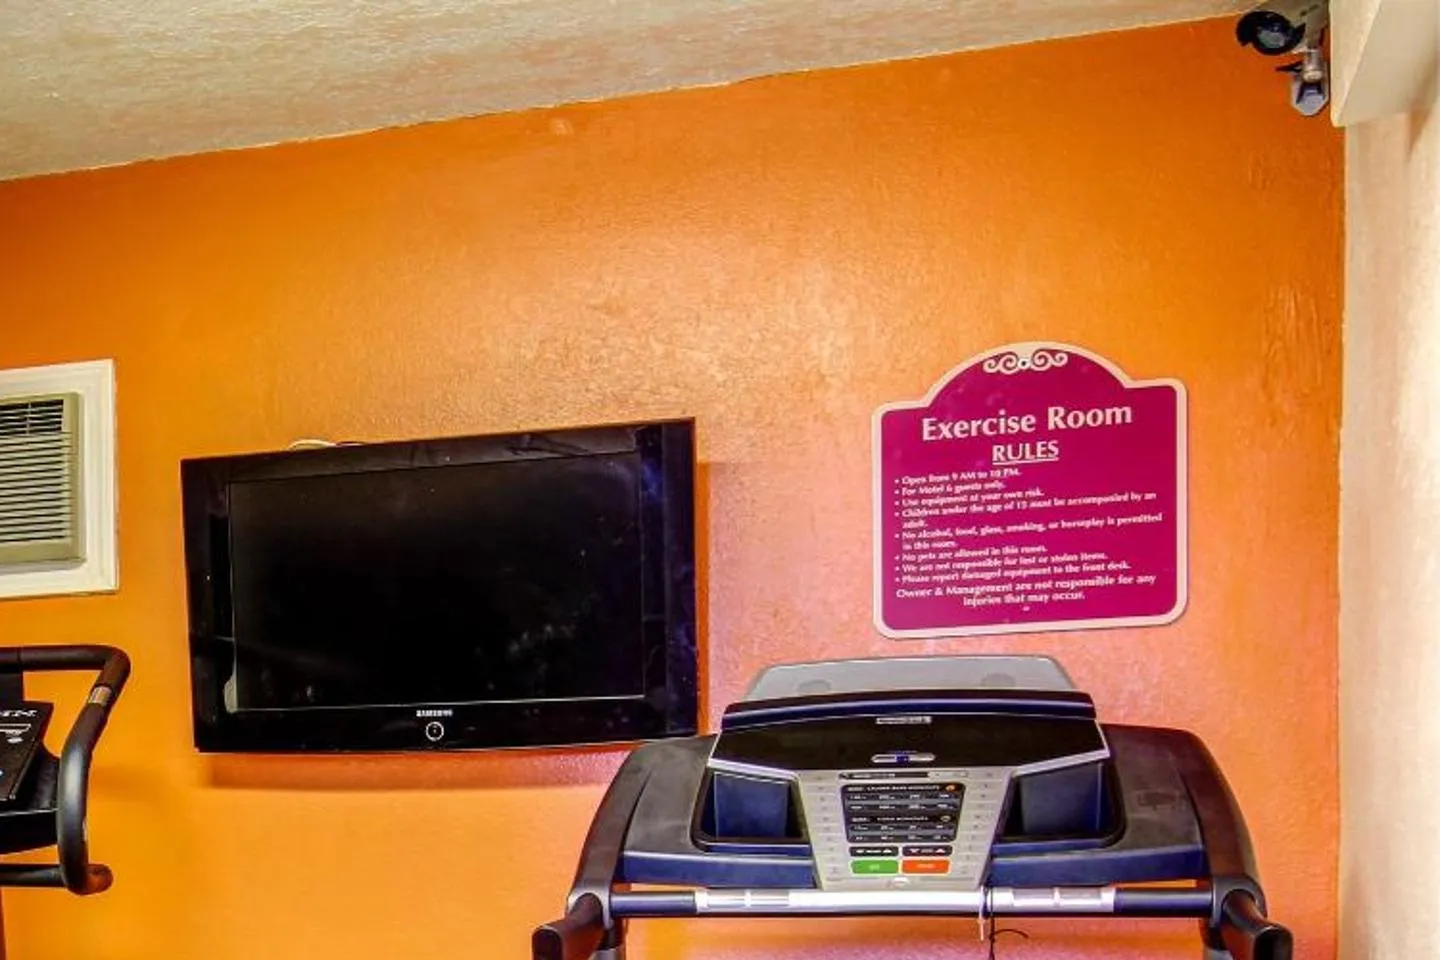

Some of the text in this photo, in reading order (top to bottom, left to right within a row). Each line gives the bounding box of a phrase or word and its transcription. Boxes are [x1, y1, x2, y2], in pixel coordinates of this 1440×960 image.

[921, 405, 1132, 442] Exercise Room
[992, 441, 1059, 462] RULES
[902, 475, 926, 486] Open
[959, 471, 976, 480] AM
[902, 487, 916, 496] For
[954, 482, 982, 494] guests
[902, 506, 940, 517] Children
[941, 504, 967, 514] under
[969, 503, 984, 513] the
[986, 504, 1002, 513] age
[1003, 501, 1014, 510] of
[1029, 498, 1052, 508] must
[1053, 497, 1066, 506] be
[1067, 492, 1129, 505] accompanied
[1130, 491, 1143, 502] by
[1143, 492, 1157, 500] an
[920, 495, 968, 507] equipment
[969, 493, 979, 502] at
[980, 493, 1002, 502] your
[1003, 491, 1024, 499] own
[1061, 517, 1105, 529] horseplay
[1106, 515, 1115, 525] is
[1117, 512, 1162, 526] permitted
[902, 553, 916, 561] No
[918, 551, 936, 562] pets
[938, 551, 953, 559] are
[954, 547, 990, 558] allowed
[990, 547, 1001, 555] in
[1002, 545, 1019, 554] this
[913, 540, 930, 550] this
[902, 564, 917, 573] We
[919, 563, 934, 571] are
[935, 562, 951, 570] not
[952, 557, 1002, 571] responsible
[1003, 556, 1018, 565] for
[1019, 556, 1036, 565] lost
[1050, 553, 1078, 562] stolen
[902, 574, 931, 583] Please
[931, 572, 959, 582] report
[961, 569, 1001, 581] damaged
[1003, 566, 1051, 579] equipment
[1065, 563, 1080, 573] the
[1082, 562, 1105, 572] front
[896, 574, 1157, 599] Owner & Management are not responsible for any
[1003, 593, 1025, 603] that
[1026, 594, 1049, 604] may
[1051, 591, 1086, 601] occur.
